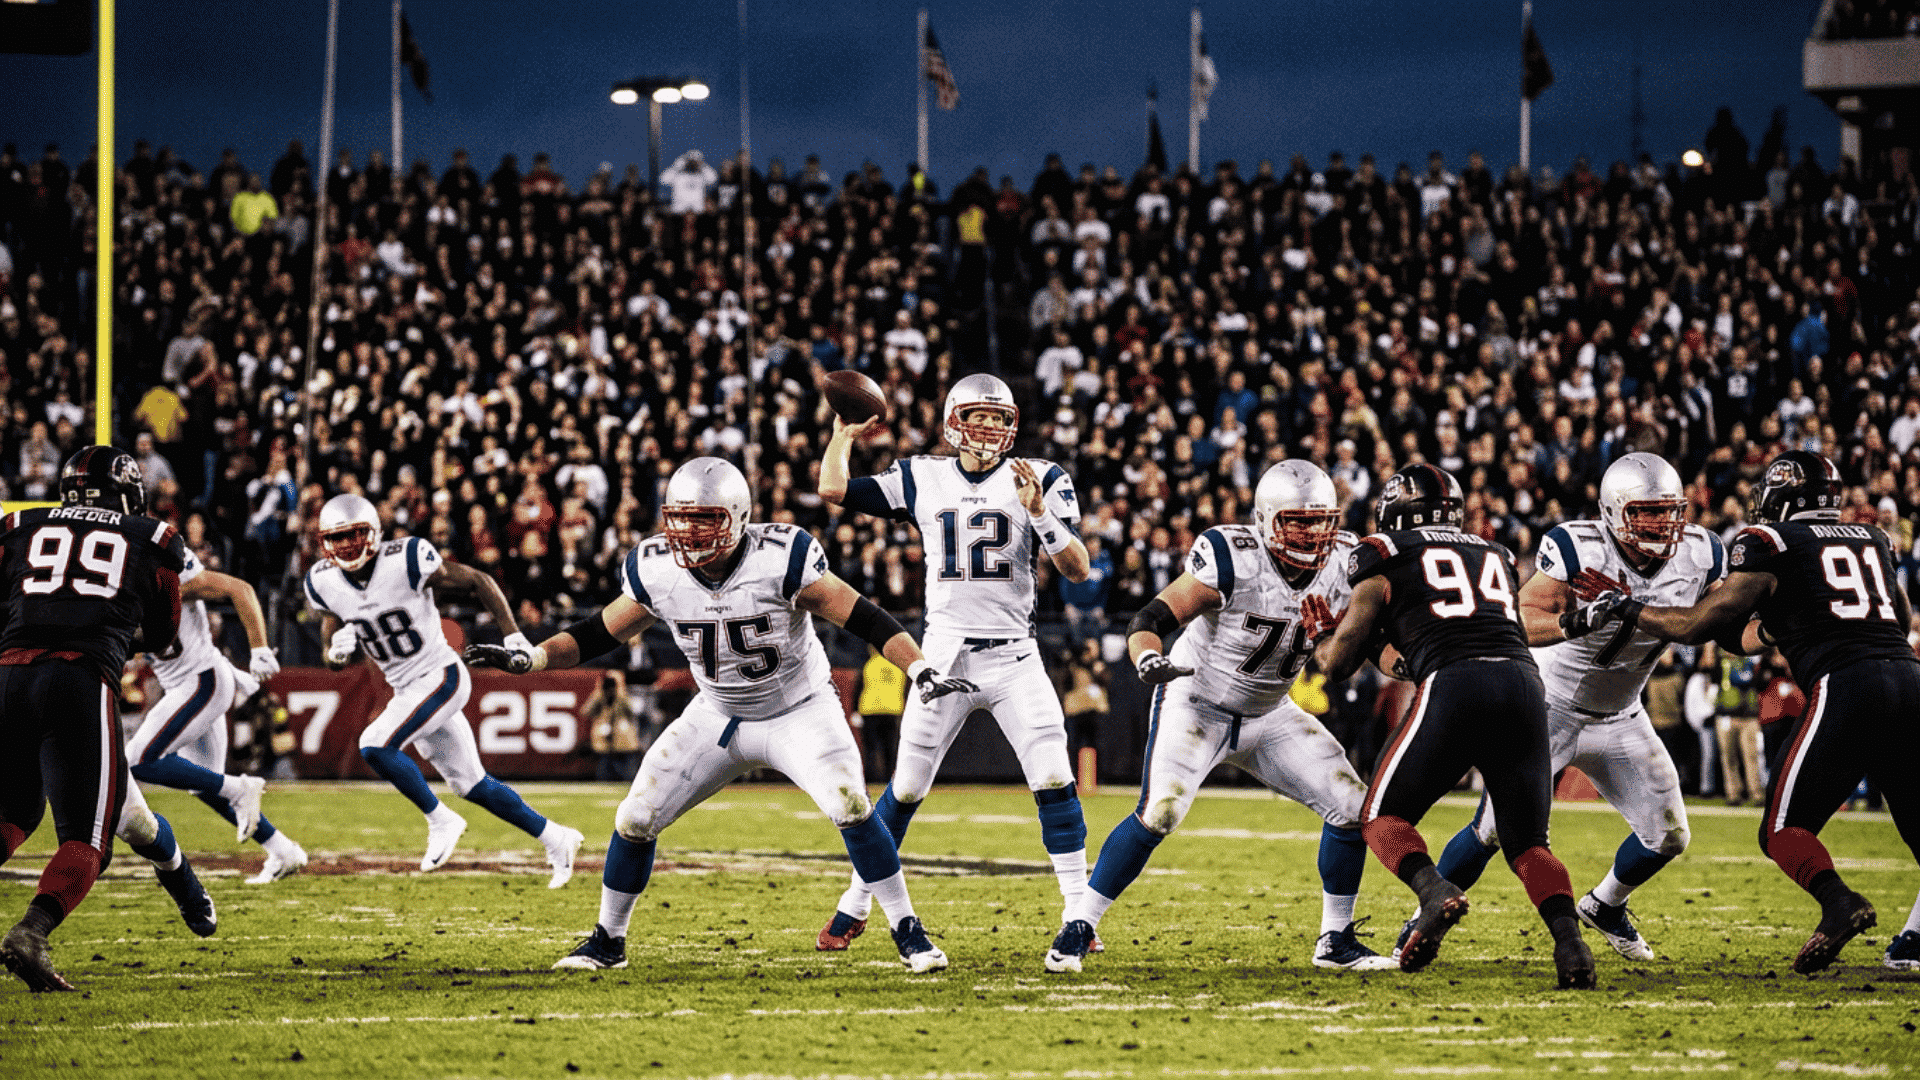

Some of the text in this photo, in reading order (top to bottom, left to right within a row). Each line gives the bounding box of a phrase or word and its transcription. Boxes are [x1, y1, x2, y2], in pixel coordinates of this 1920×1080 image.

[21, 525, 129, 598] 99
[935, 508, 1013, 582] 12
[1421, 546, 1518, 623] 94
[1820, 544, 1898, 621] 91
[674, 612, 782, 683] 75
[287, 691, 340, 754] 7
[479, 691, 577, 753] 25
